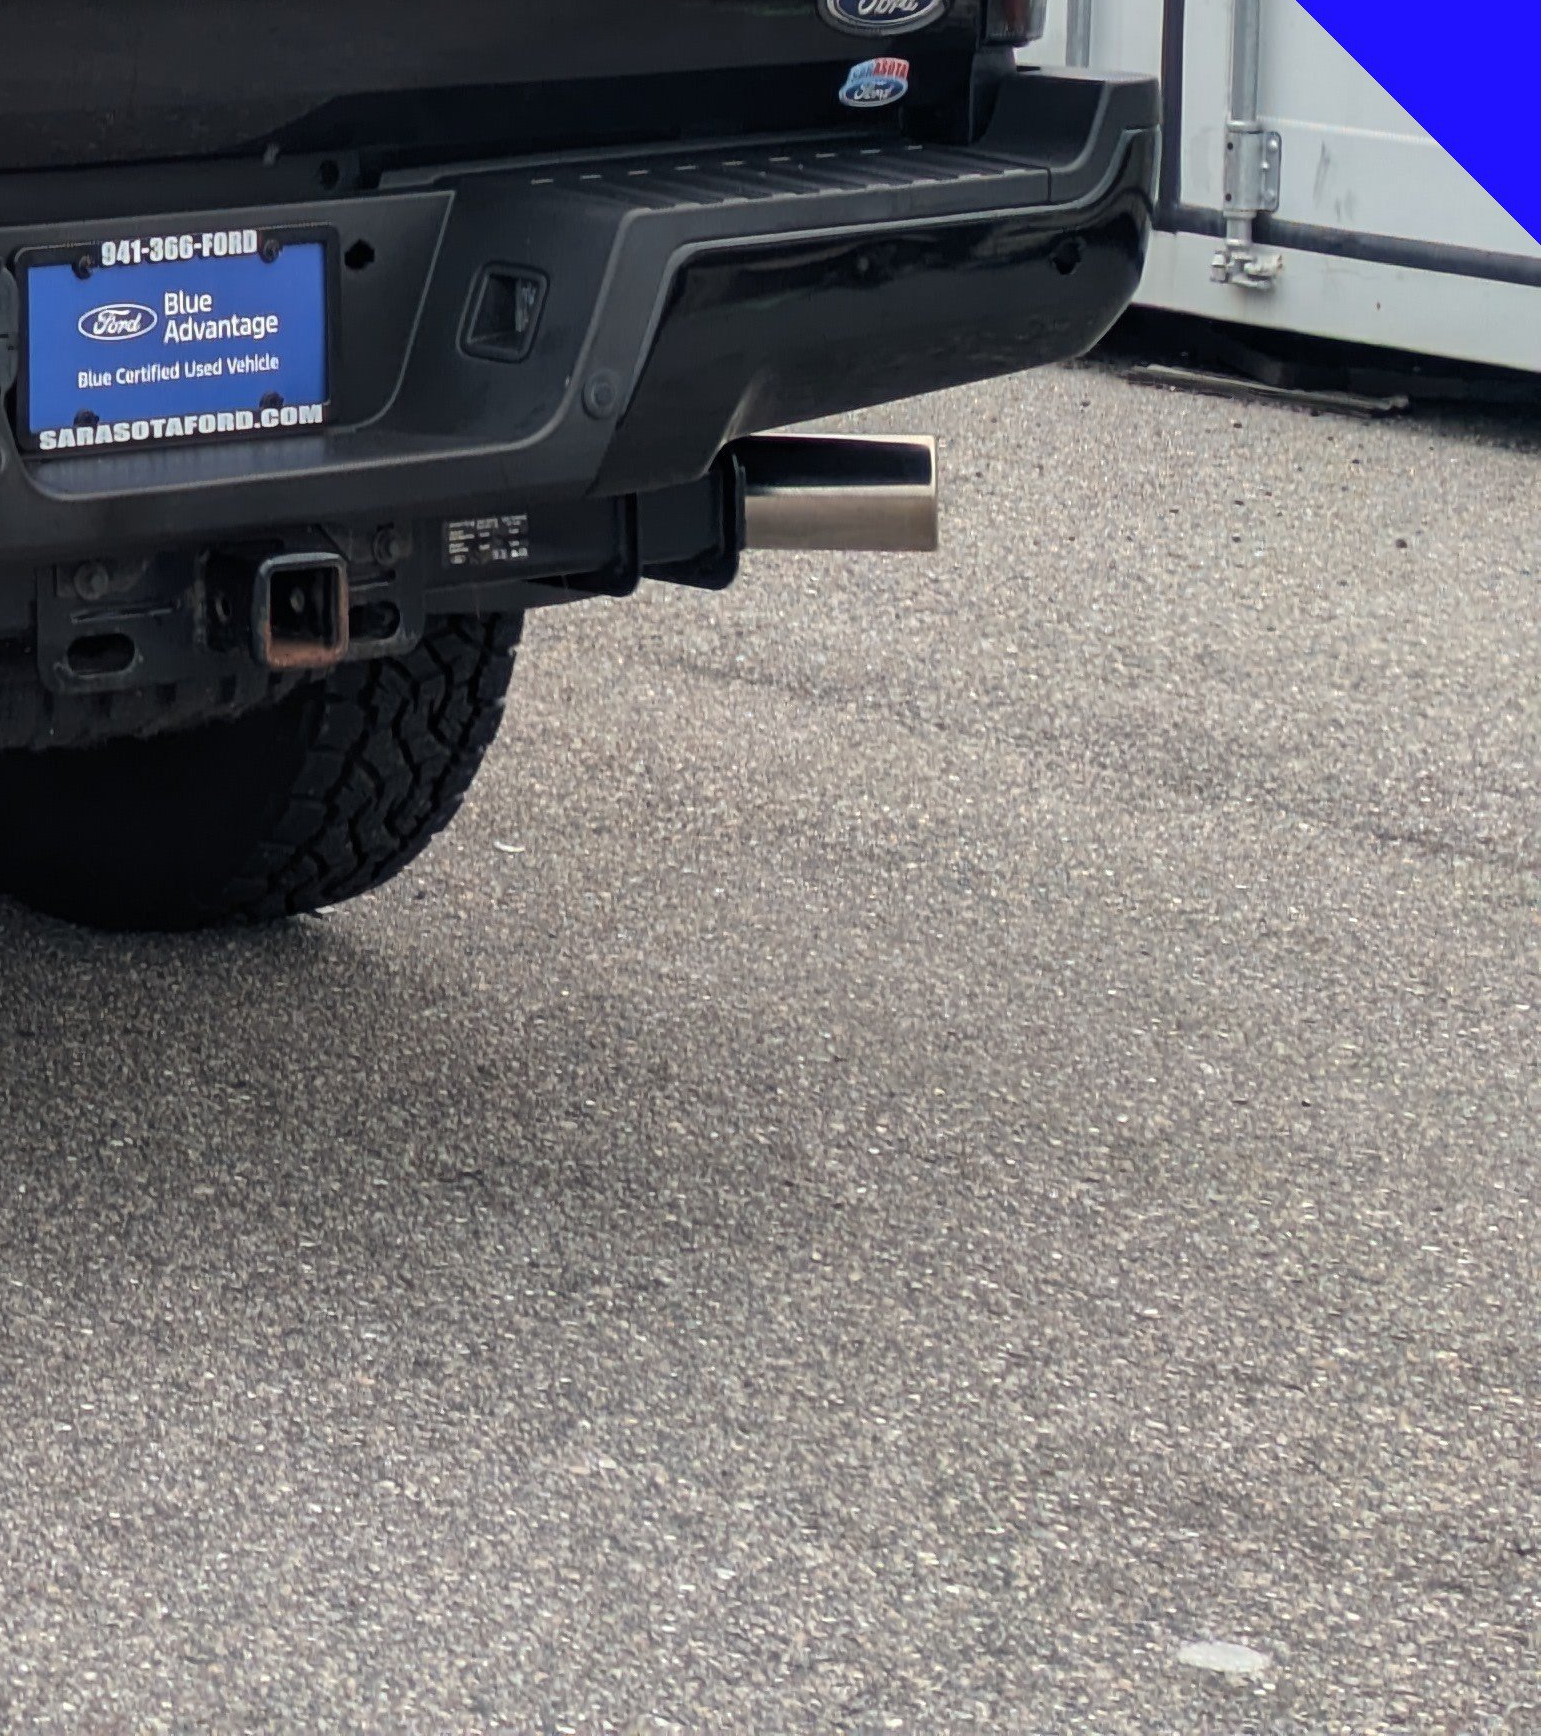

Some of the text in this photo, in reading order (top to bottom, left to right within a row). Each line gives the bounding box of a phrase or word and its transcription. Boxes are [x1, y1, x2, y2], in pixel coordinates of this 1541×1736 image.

[101, 228, 258, 266] 941-366-FORD
[163, 289, 213, 315] Blue
[90, 307, 145, 337] Ford
[163, 313, 279, 345] Advantage
[77, 353, 279, 389] Blue Certified Used Vehicle
[38, 403, 324, 451] SARASOTAFORD.COM
